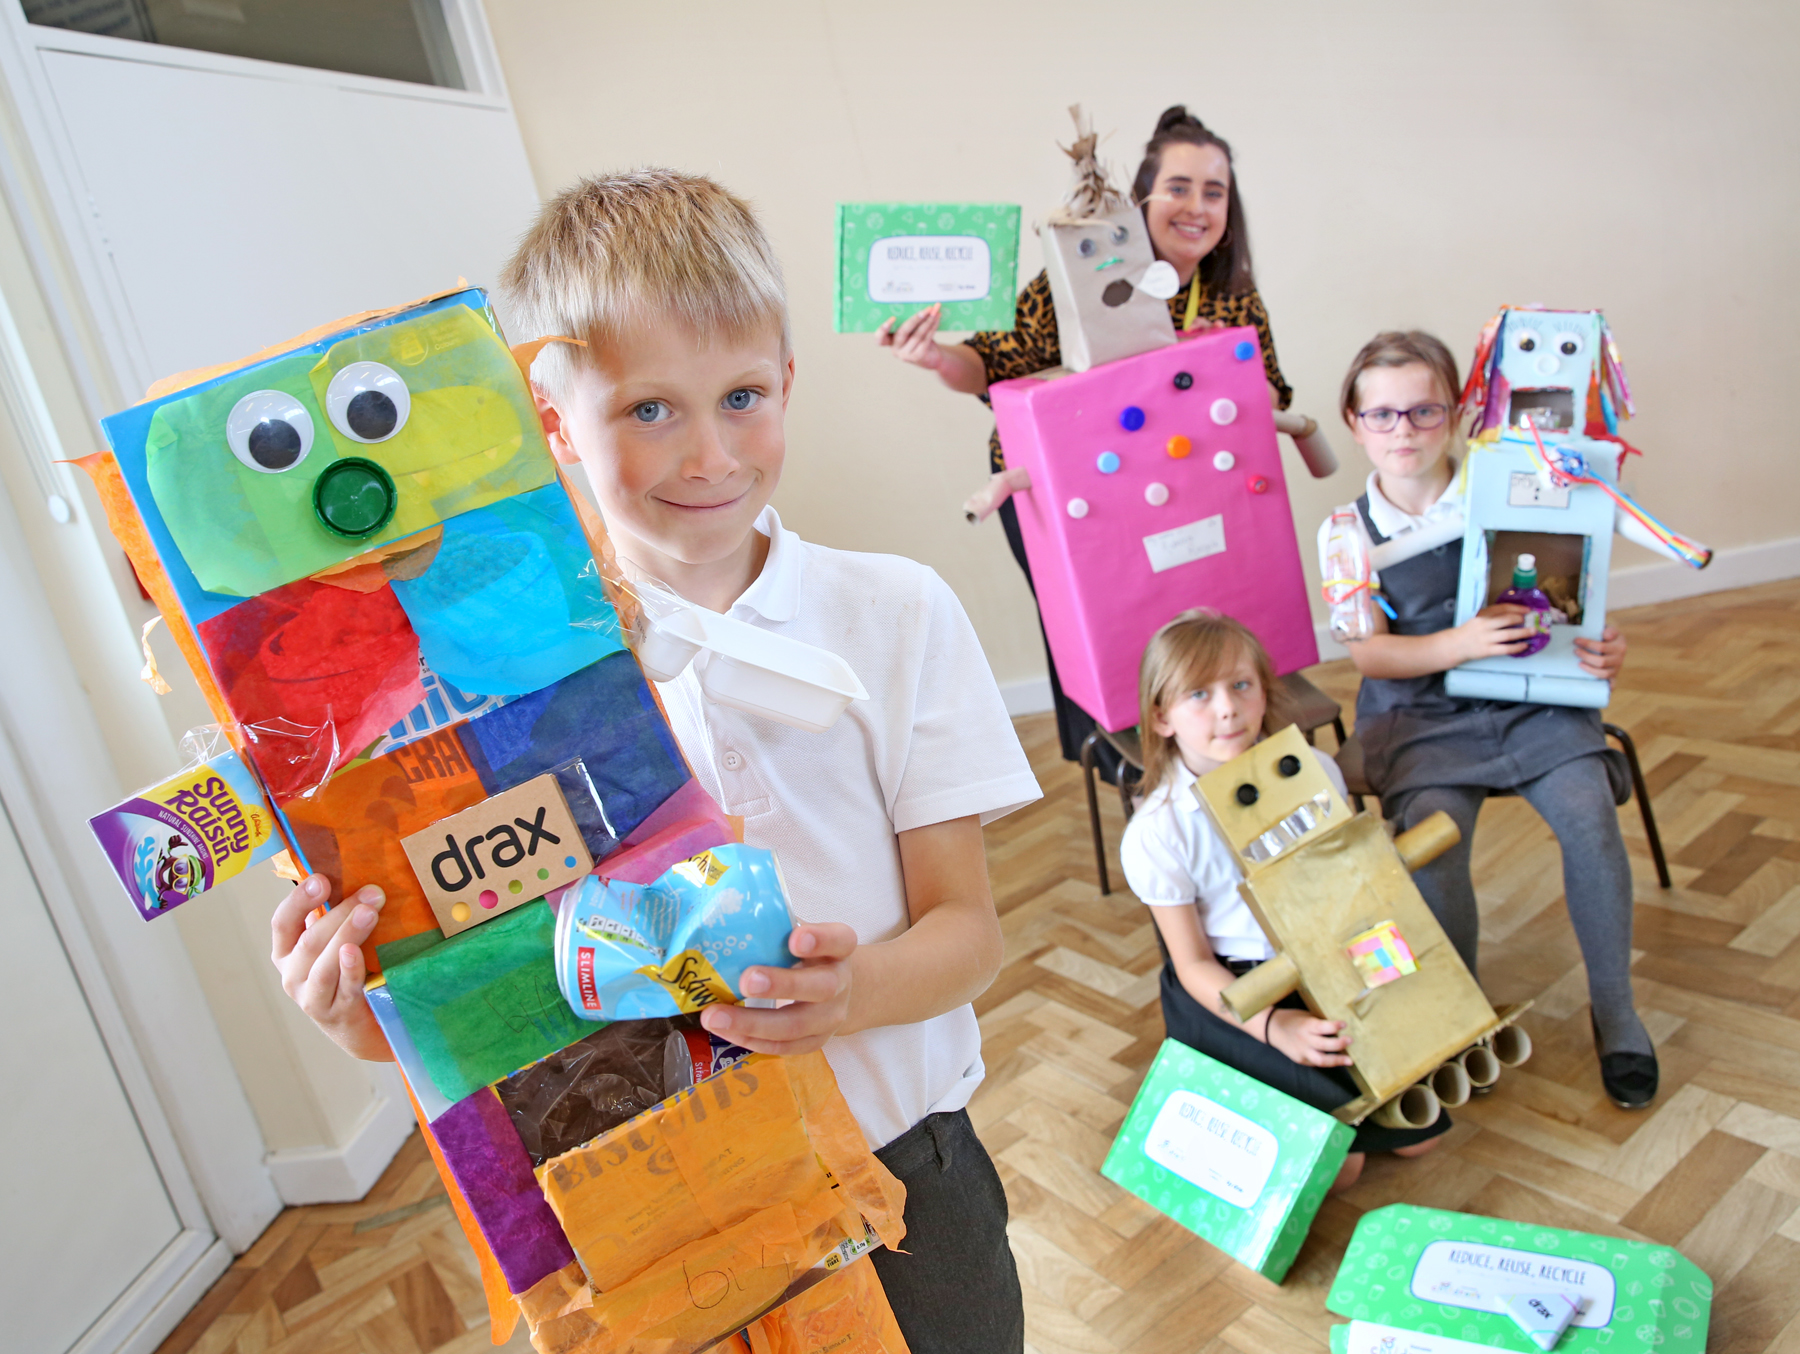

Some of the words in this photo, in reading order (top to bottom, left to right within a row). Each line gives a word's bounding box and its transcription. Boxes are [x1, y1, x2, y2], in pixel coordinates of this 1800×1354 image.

[158, 810, 182, 829] NATURAL
[181, 824, 201, 846] SUNSHINE
[164, 788, 231, 867] Raisin
[193, 776, 250, 854] Sunny
[431, 806, 561, 892] drax
[580, 951, 598, 1009] SLIMLINE
[551, 1060, 760, 1195] BISCUITS
[1448, 1248, 1493, 1270] REDUCE,
[1497, 1256, 1535, 1278] REUSE,
[1538, 1264, 1587, 1286] RECYCLE
[1528, 1298, 1554, 1319] drax
